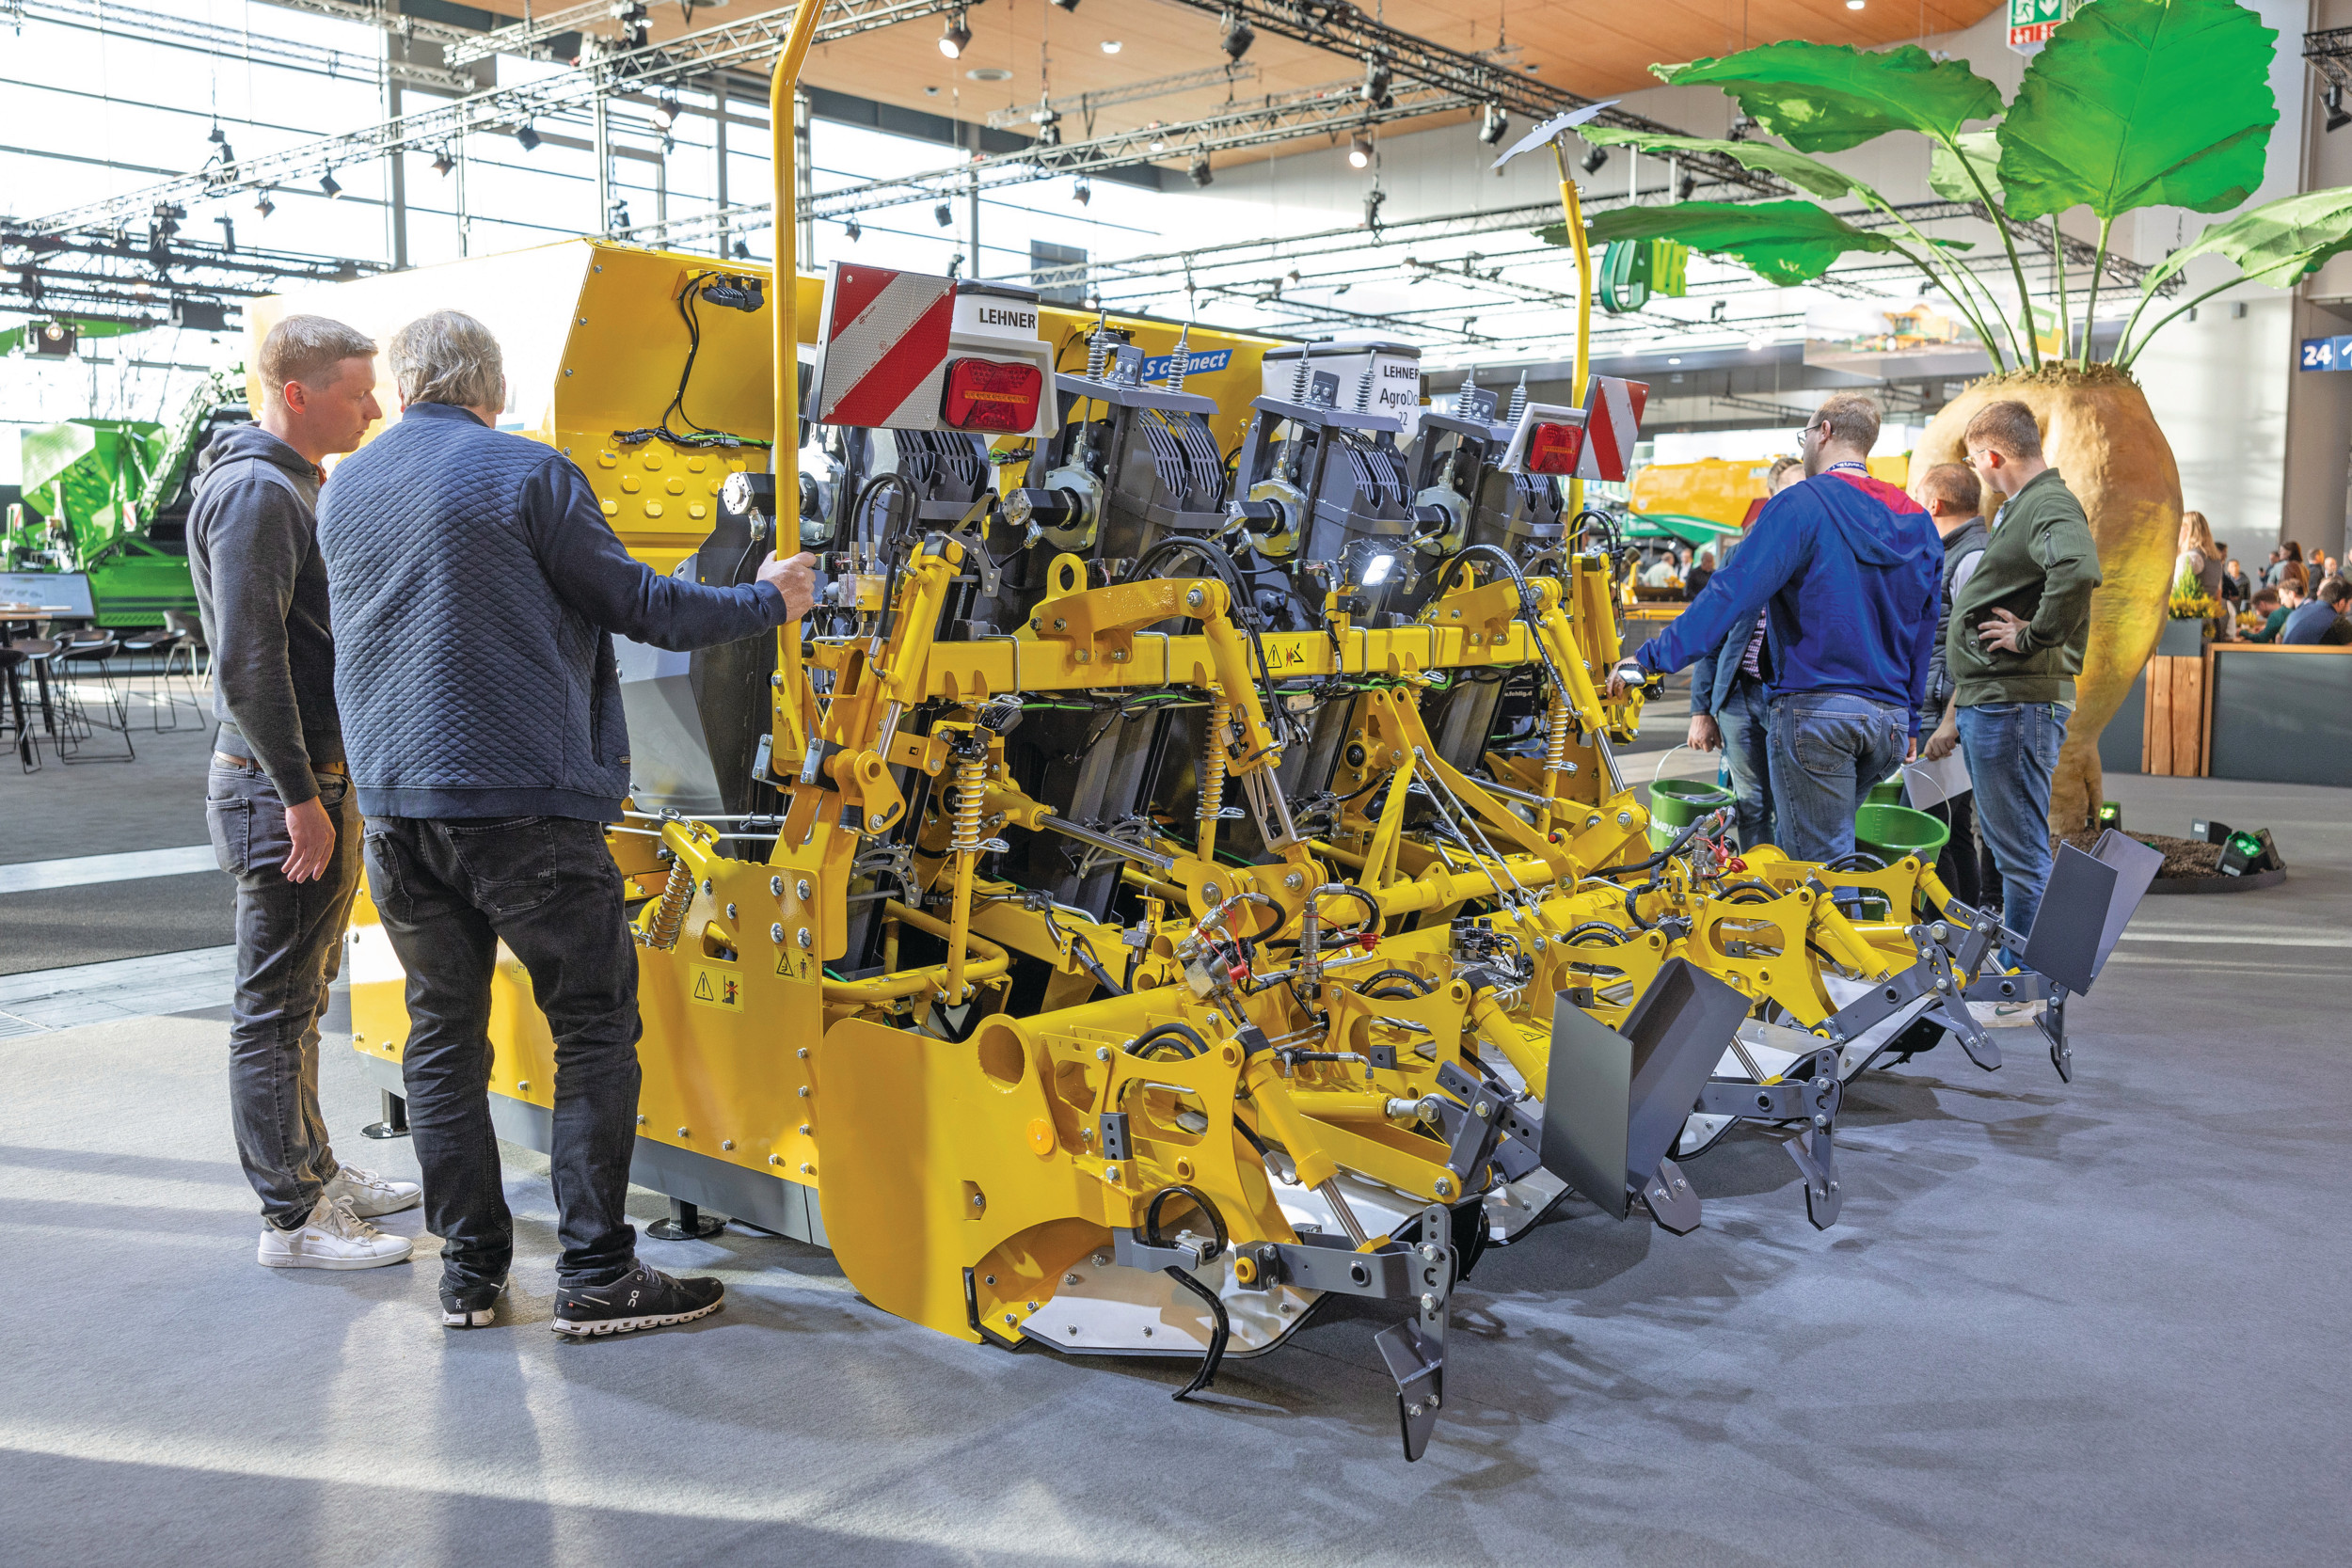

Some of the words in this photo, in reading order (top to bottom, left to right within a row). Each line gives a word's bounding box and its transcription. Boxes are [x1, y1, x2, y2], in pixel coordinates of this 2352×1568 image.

[979, 308, 1036, 329] LEHNER
[2304, 344, 2332, 366] 24
[1384, 365, 1419, 380] LEHNER
